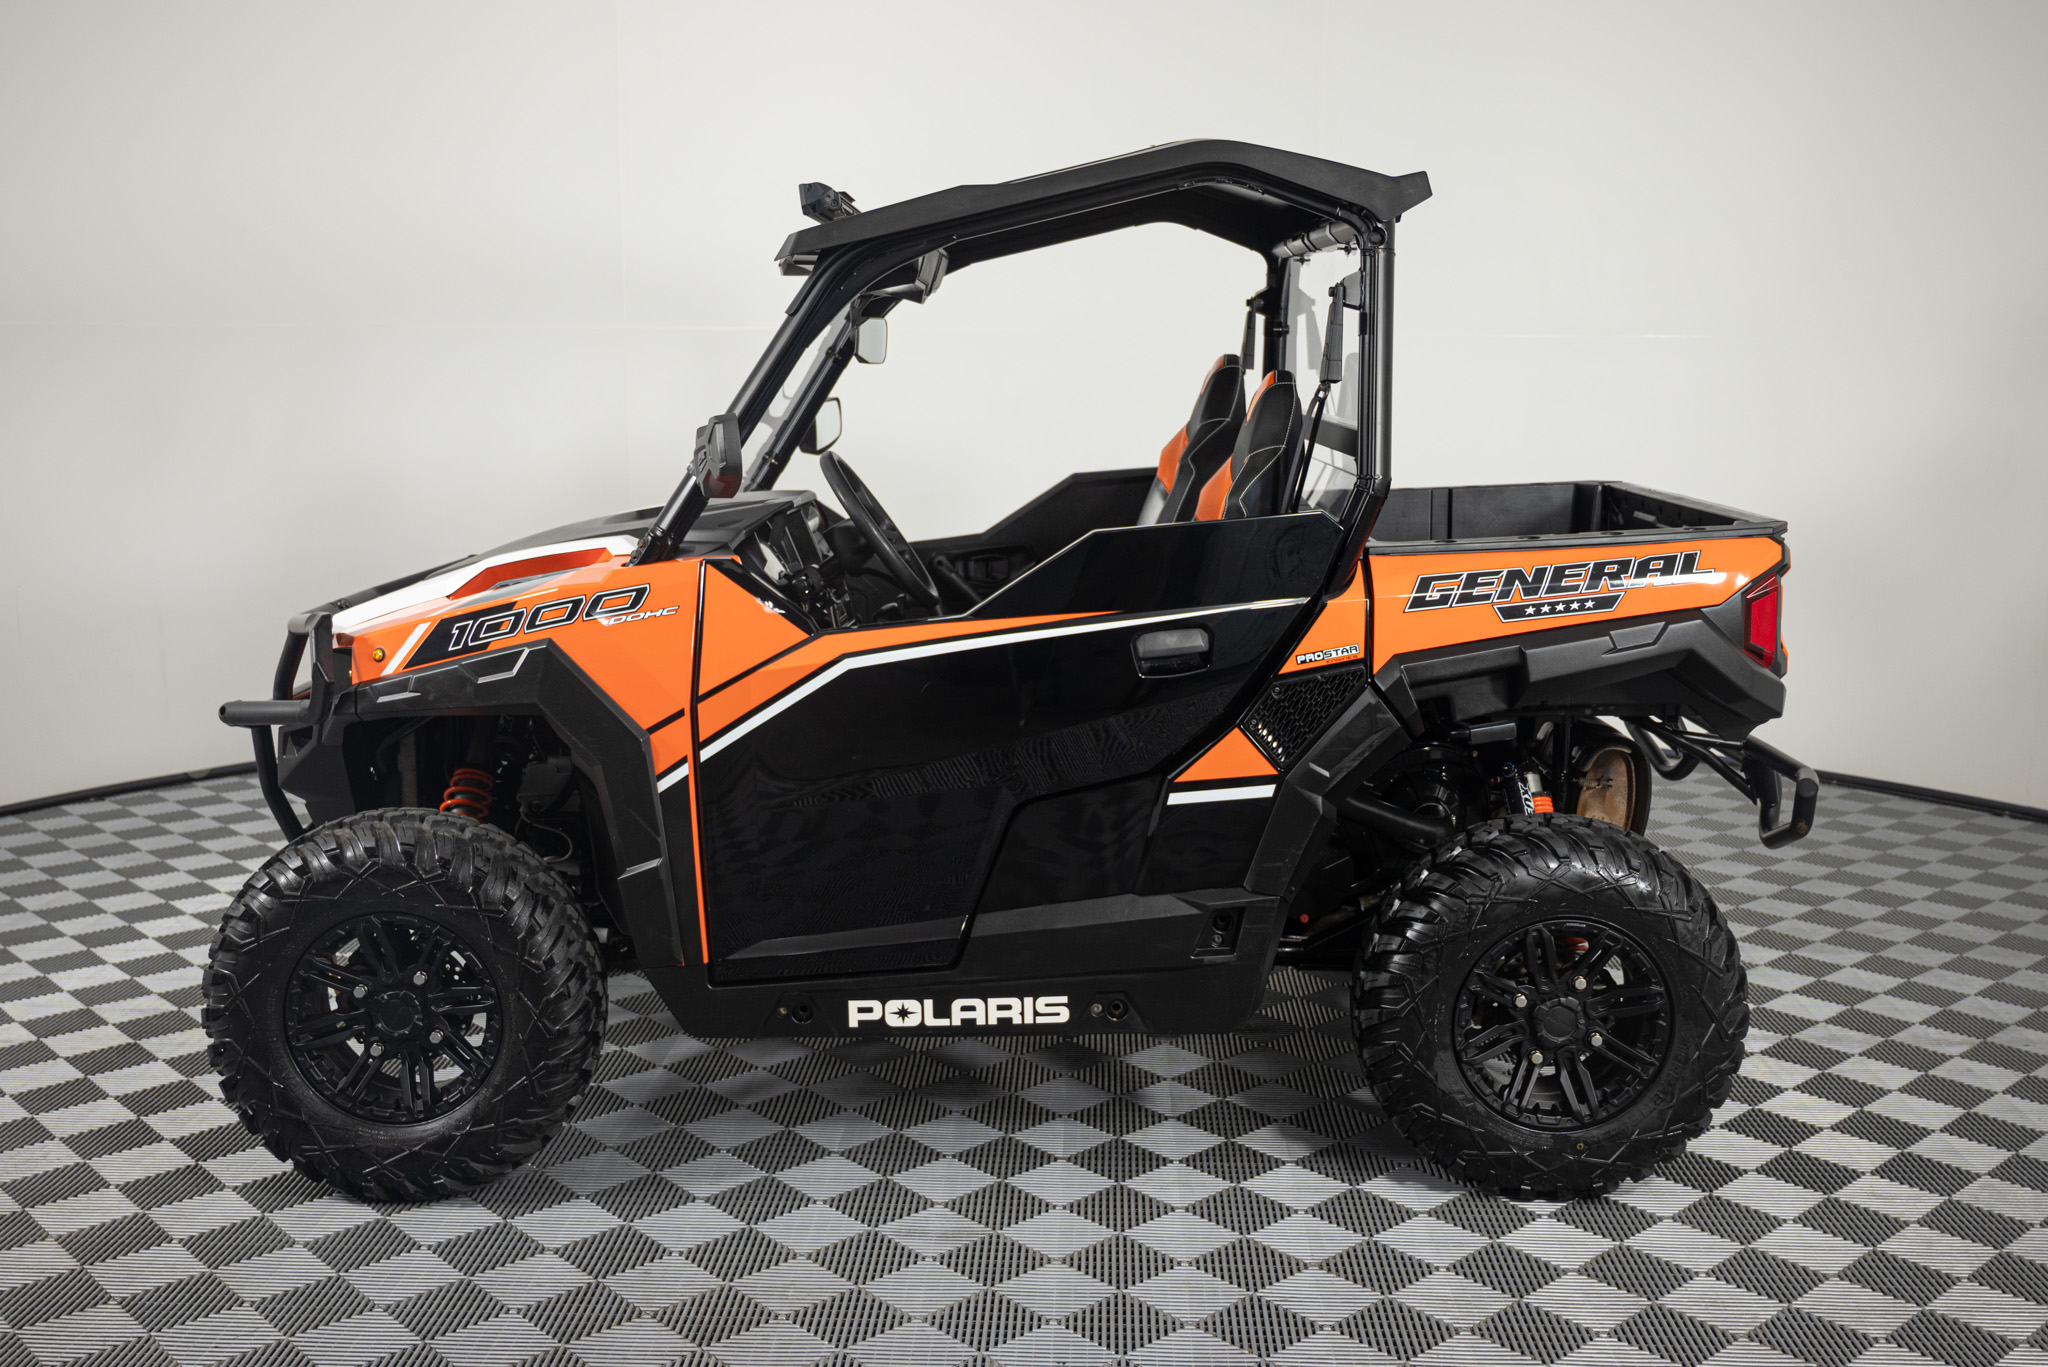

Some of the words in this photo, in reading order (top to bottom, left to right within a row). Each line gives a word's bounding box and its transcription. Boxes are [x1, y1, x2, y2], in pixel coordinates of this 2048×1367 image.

[1403, 550, 1715, 613] GENERAL
[448, 583, 651, 651] 1000
[608, 605, 680, 625] DOHC
[1296, 644, 1359, 665] PROSTAR
[848, 996, 1070, 1027] POLARIS
